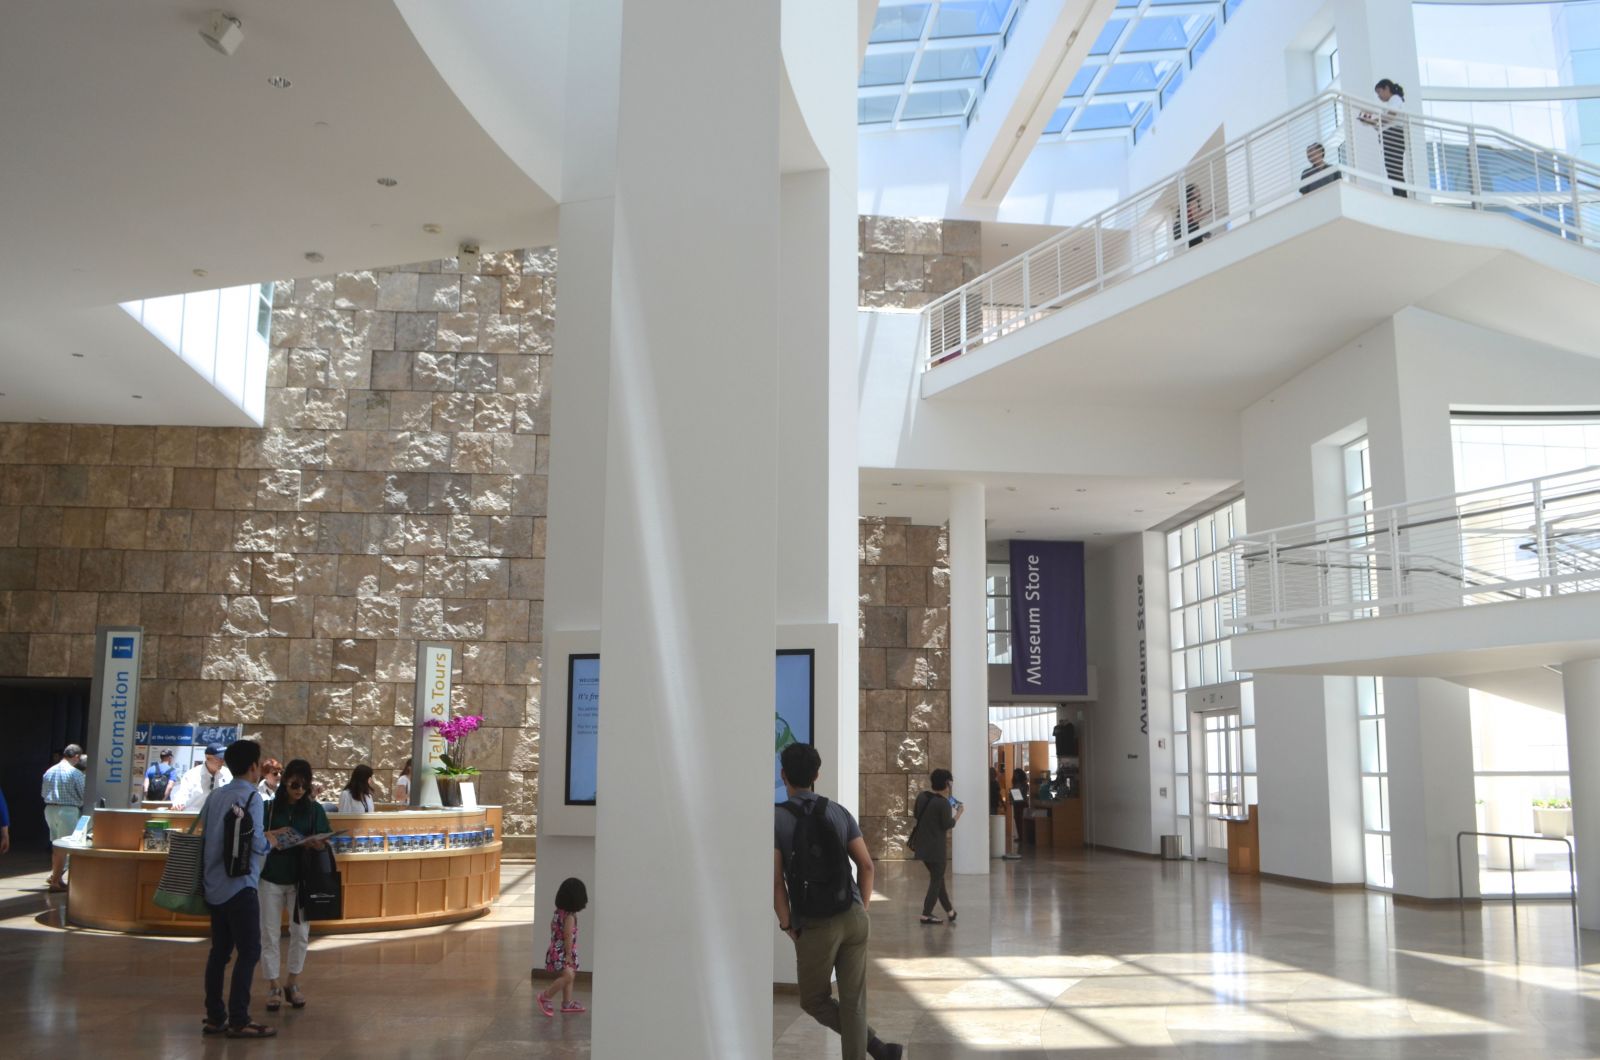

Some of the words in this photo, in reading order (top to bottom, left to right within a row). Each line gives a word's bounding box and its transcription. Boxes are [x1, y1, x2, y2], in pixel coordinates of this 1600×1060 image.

[1025, 554, 1040, 601] Store
[1137, 573, 1145, 632] Store
[1026, 607, 1042, 686] Museum
[431, 653, 446, 699] Tours
[1137, 639, 1148, 735] Museum
[105, 671, 129, 784] Information
[431, 703, 444, 716] &
[428, 726, 446, 763] Talk
